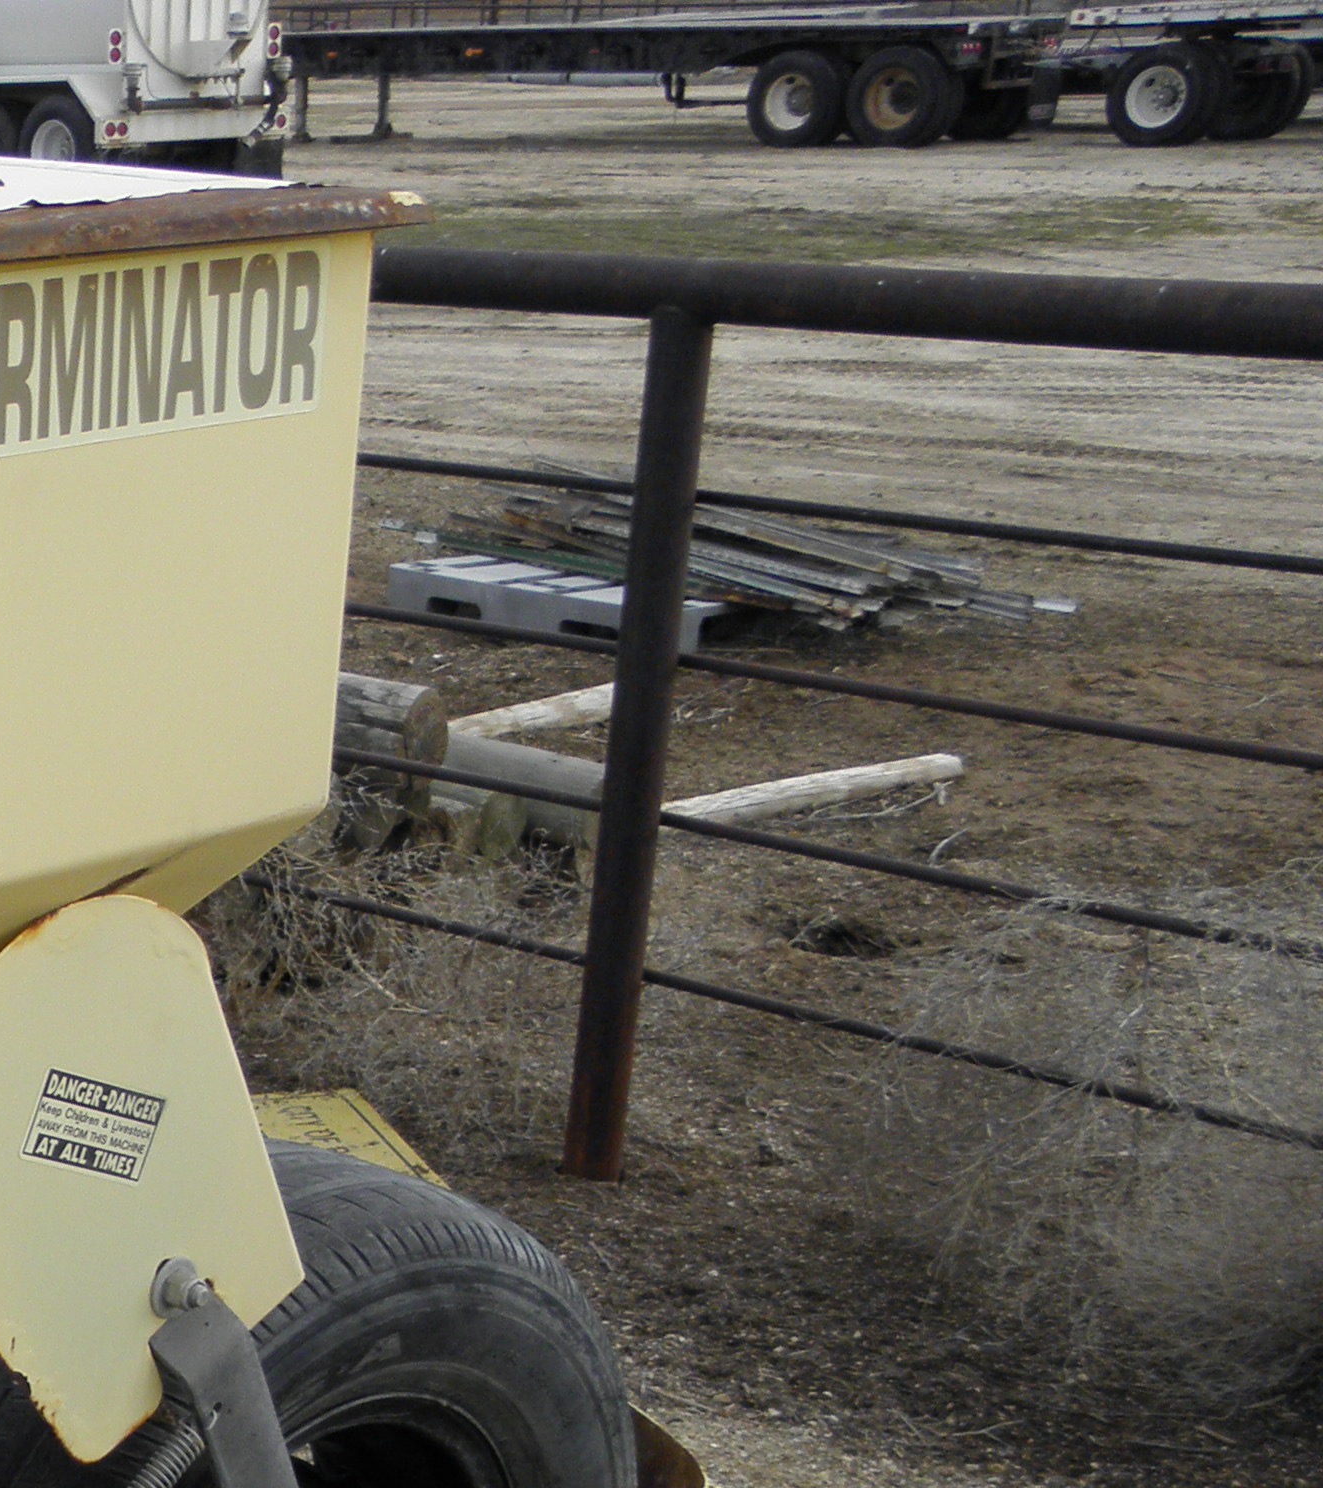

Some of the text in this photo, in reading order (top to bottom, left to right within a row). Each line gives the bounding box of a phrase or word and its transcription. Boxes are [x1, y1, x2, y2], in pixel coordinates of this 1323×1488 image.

[36, 1118, 147, 1155] AWAY FROM THIS MACHINE
[40, 1101, 152, 1140] Keep Children & Livestock
[35, 1136, 135, 1176] AT ALL TIMES
